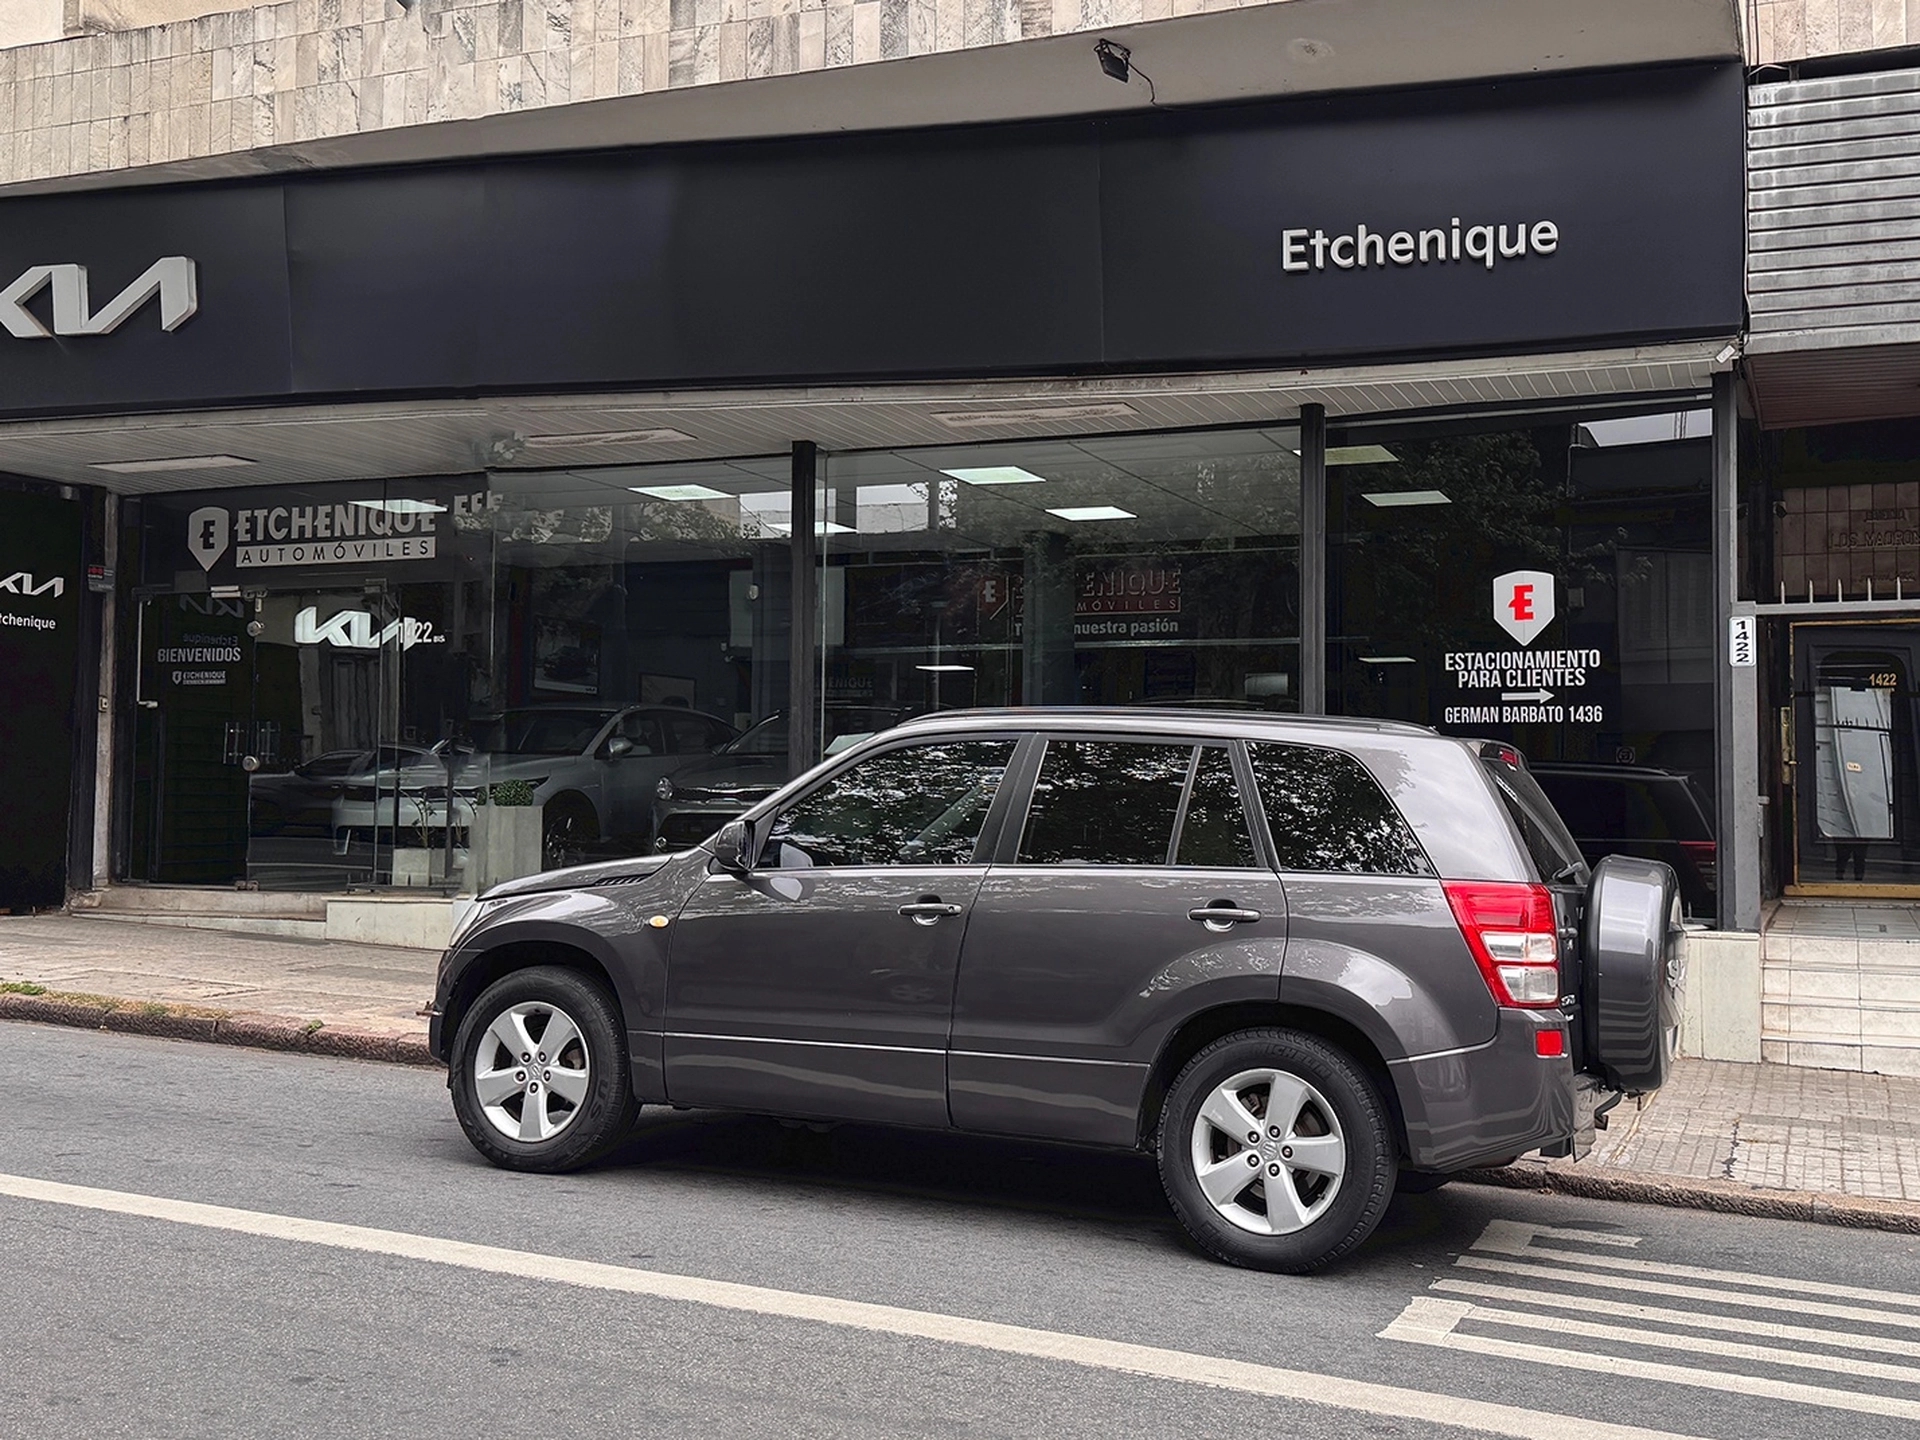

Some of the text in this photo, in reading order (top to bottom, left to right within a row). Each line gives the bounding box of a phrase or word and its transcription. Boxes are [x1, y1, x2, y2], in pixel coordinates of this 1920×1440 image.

[1282, 217, 1559, 271] Etchenique
[234, 500, 436, 541] ETCHENIQUE
[241, 540, 429, 564] AUTOMÓVILES
[398, 621, 432, 644] 122
[1074, 617, 1178, 637] nuestra pasión
[1735, 620, 1750, 663] 1422
[157, 647, 242, 664] BIENVENIDOS
[1445, 649, 1601, 671] ESTACIONAMIENTO
[1458, 668, 1586, 688] PARA CLIENTES
[1869, 673, 1898, 687] 1422
[1444, 705, 1603, 723] GERMAN BARBATO 1436
